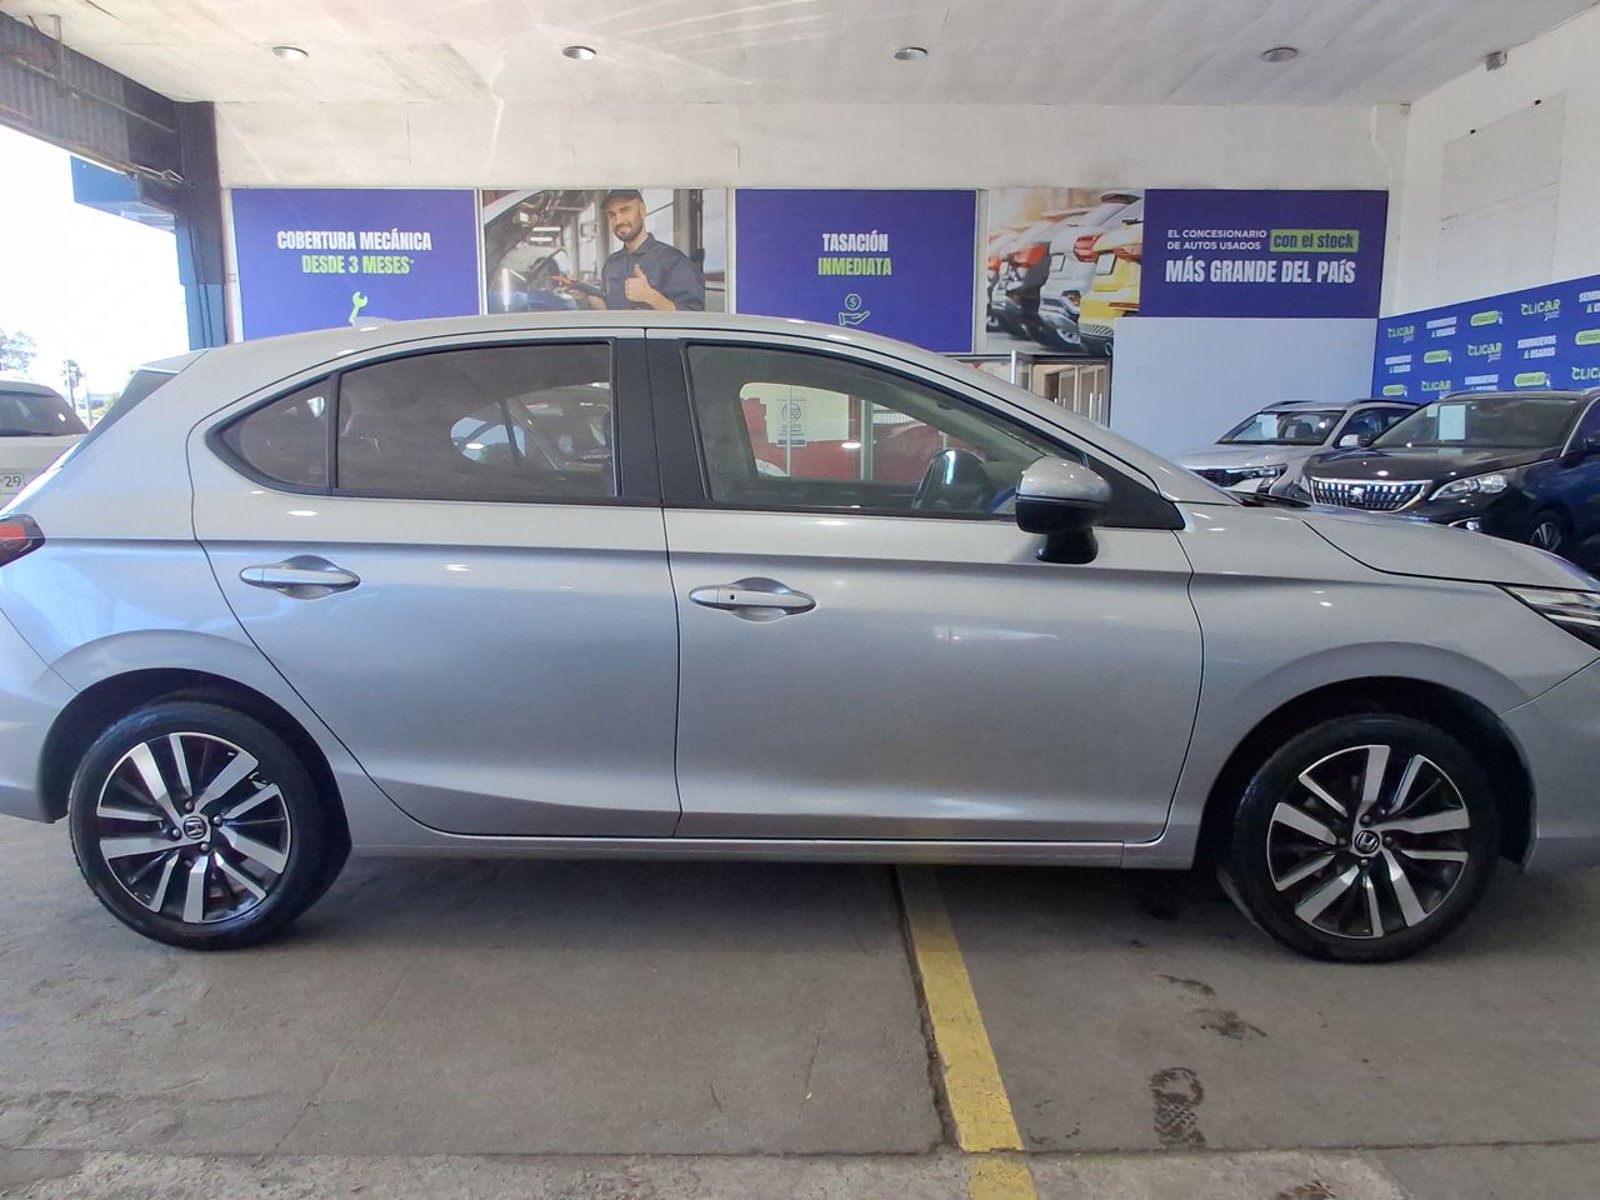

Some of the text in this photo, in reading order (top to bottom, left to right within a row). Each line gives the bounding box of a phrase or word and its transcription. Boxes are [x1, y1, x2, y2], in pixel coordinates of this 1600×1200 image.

[277, 228, 432, 250] COBERTURA MECÁNICA
[822, 229, 888, 252] TASACIÓN
[1167, 229, 1267, 238] EL CONCESIONARIO
[1274, 233, 1353, 249] con el stock
[1167, 241, 1261, 250] DE AUTOS USADOS
[302, 255, 346, 273] DESDE
[349, 255, 359, 274] 3
[818, 257, 892, 275] INMEDIATA
[1165, 255, 1205, 282] MÁS
[1210, 260, 1276, 283] GRANDE
[1281, 260, 1311, 283] DEL
